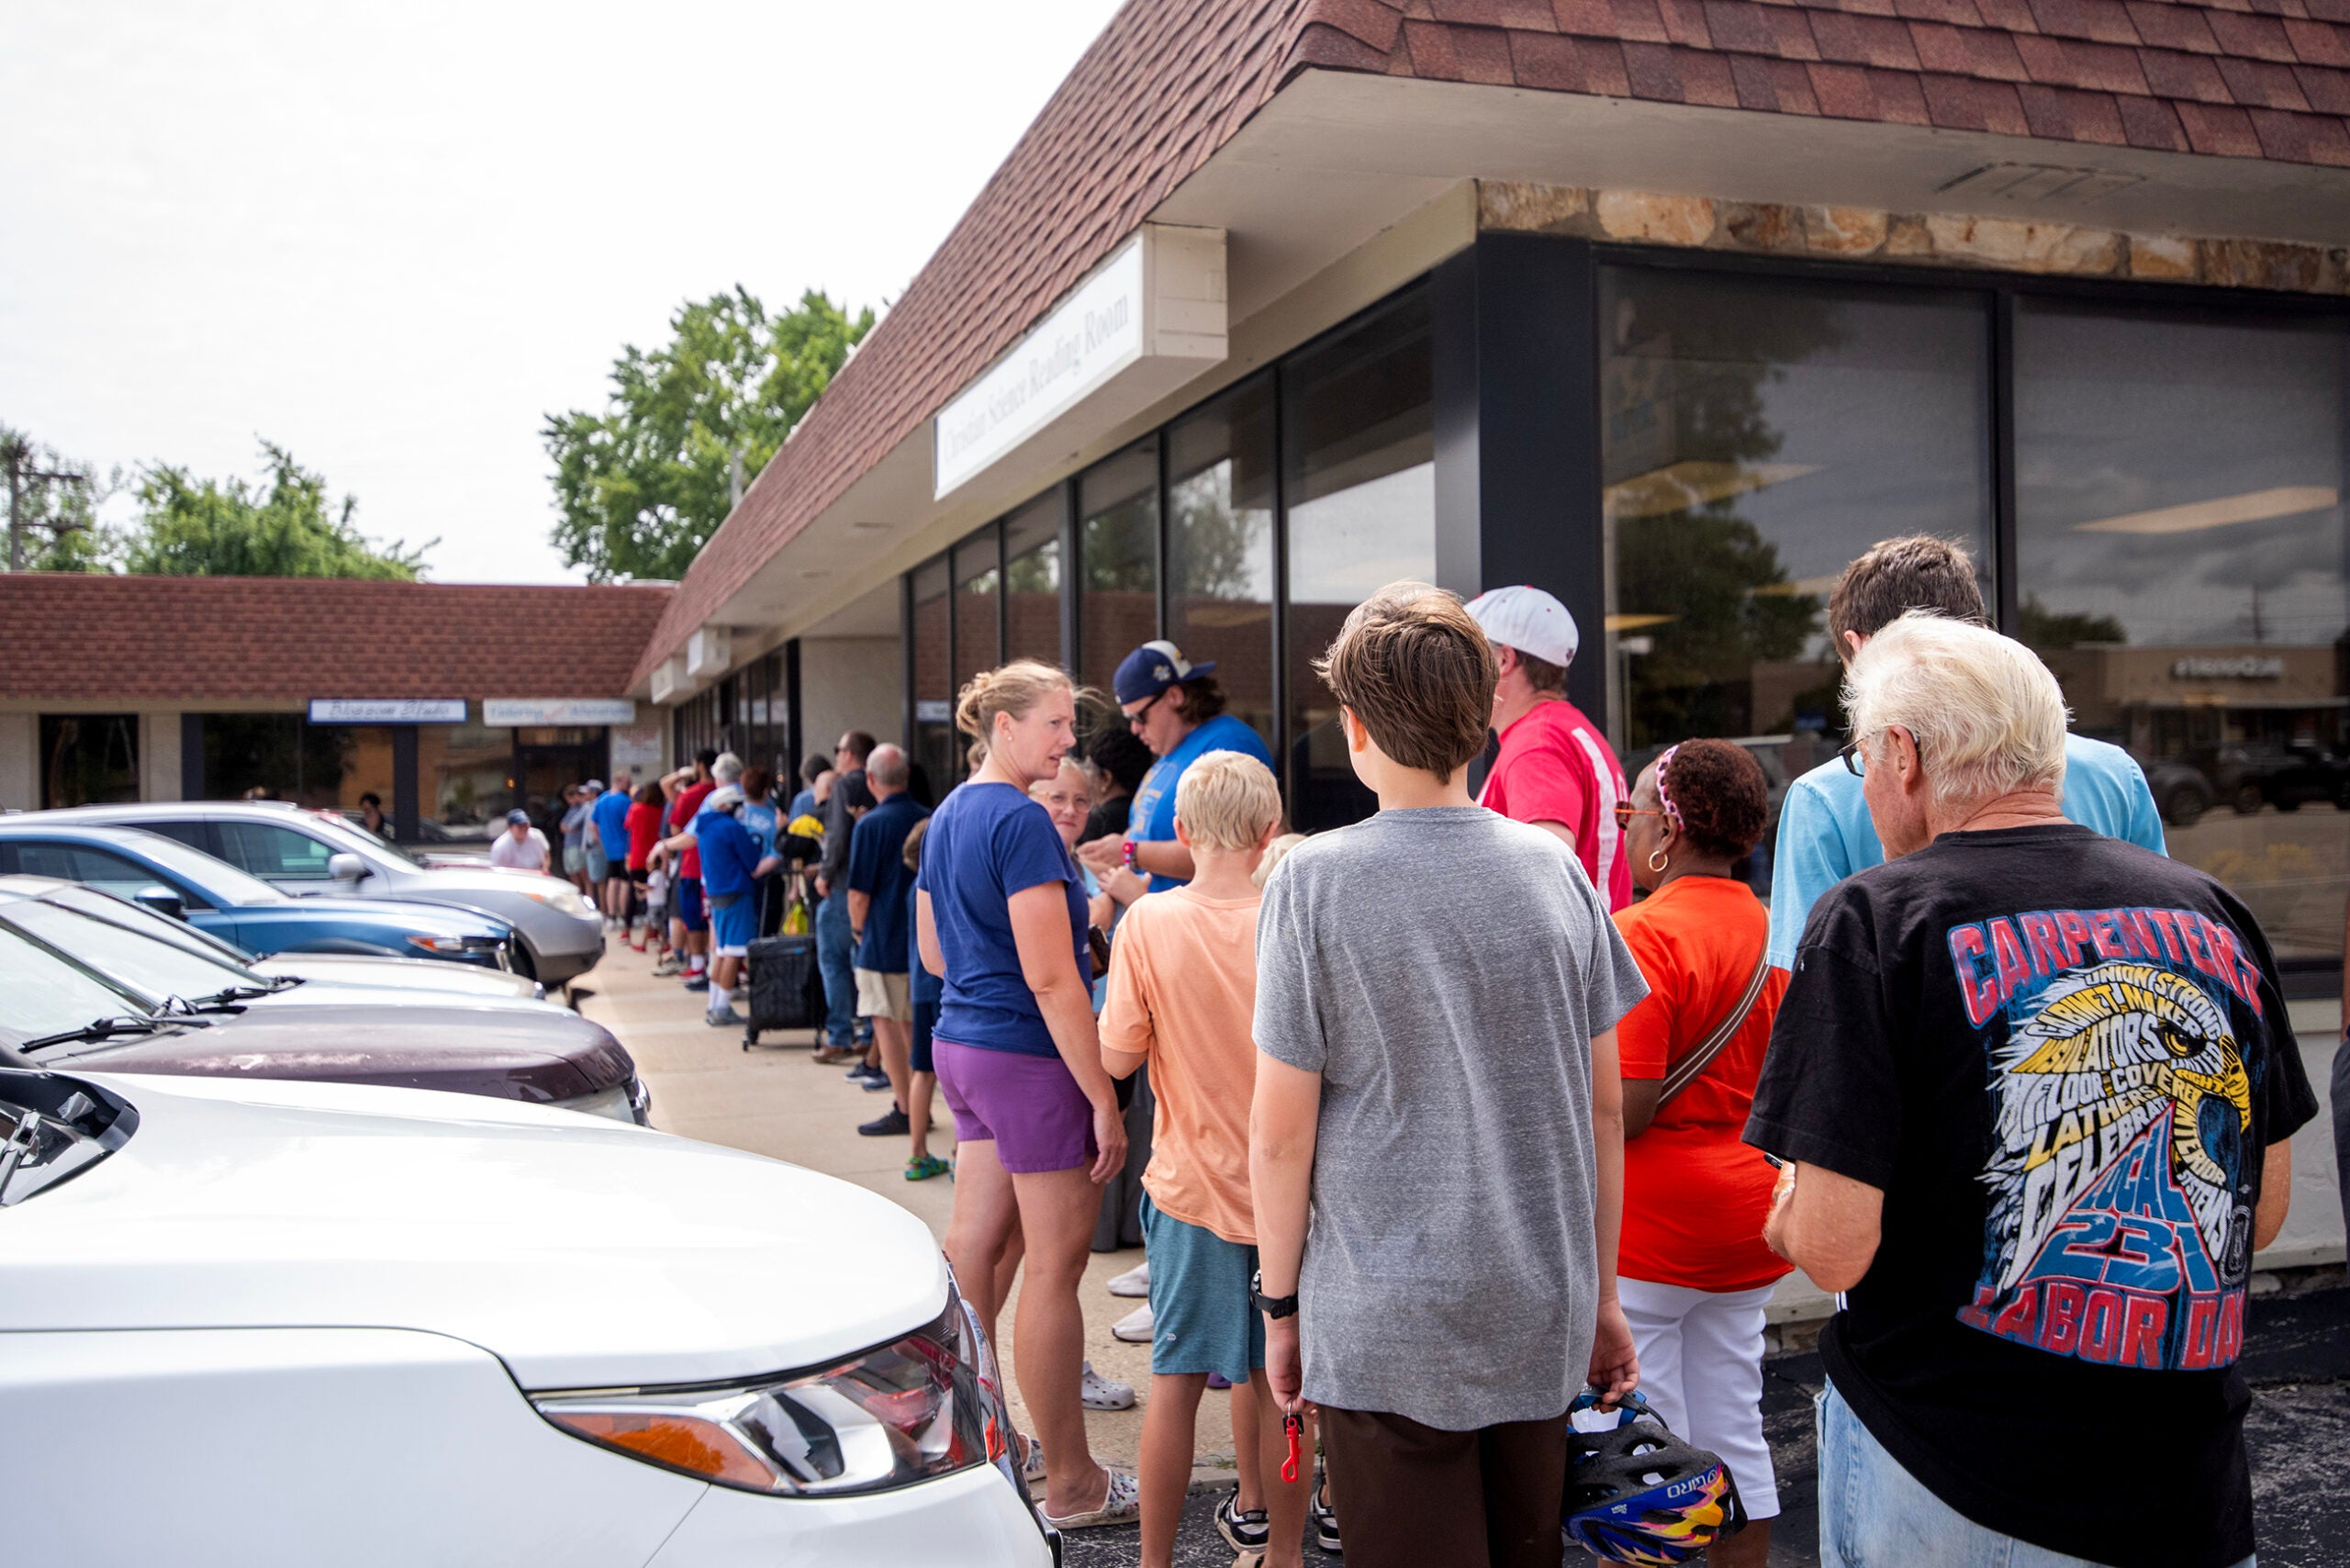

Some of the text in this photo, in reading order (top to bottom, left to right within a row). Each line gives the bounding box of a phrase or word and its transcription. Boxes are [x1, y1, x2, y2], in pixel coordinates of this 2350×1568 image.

[1028, 332, 1081, 398] Reading
[1084, 294, 1129, 354] Room
[1948, 907, 2263, 1027] CARPENTERS
[2026, 982, 2202, 1038] CABINET MAKER
[2085, 966, 2223, 1040] UNION STRONG
[2021, 1071, 2106, 1133] FLOOR
[2023, 1085, 2159, 1172] LATHERS
[2173, 1100, 2227, 1187] INTERIOR
[2017, 1210, 2221, 1295] 231
[2177, 1169, 2232, 1262] SYSTEMS
[1956, 1282, 2169, 1370] LABOR
[1666, 1474, 1707, 1499] GIRO
